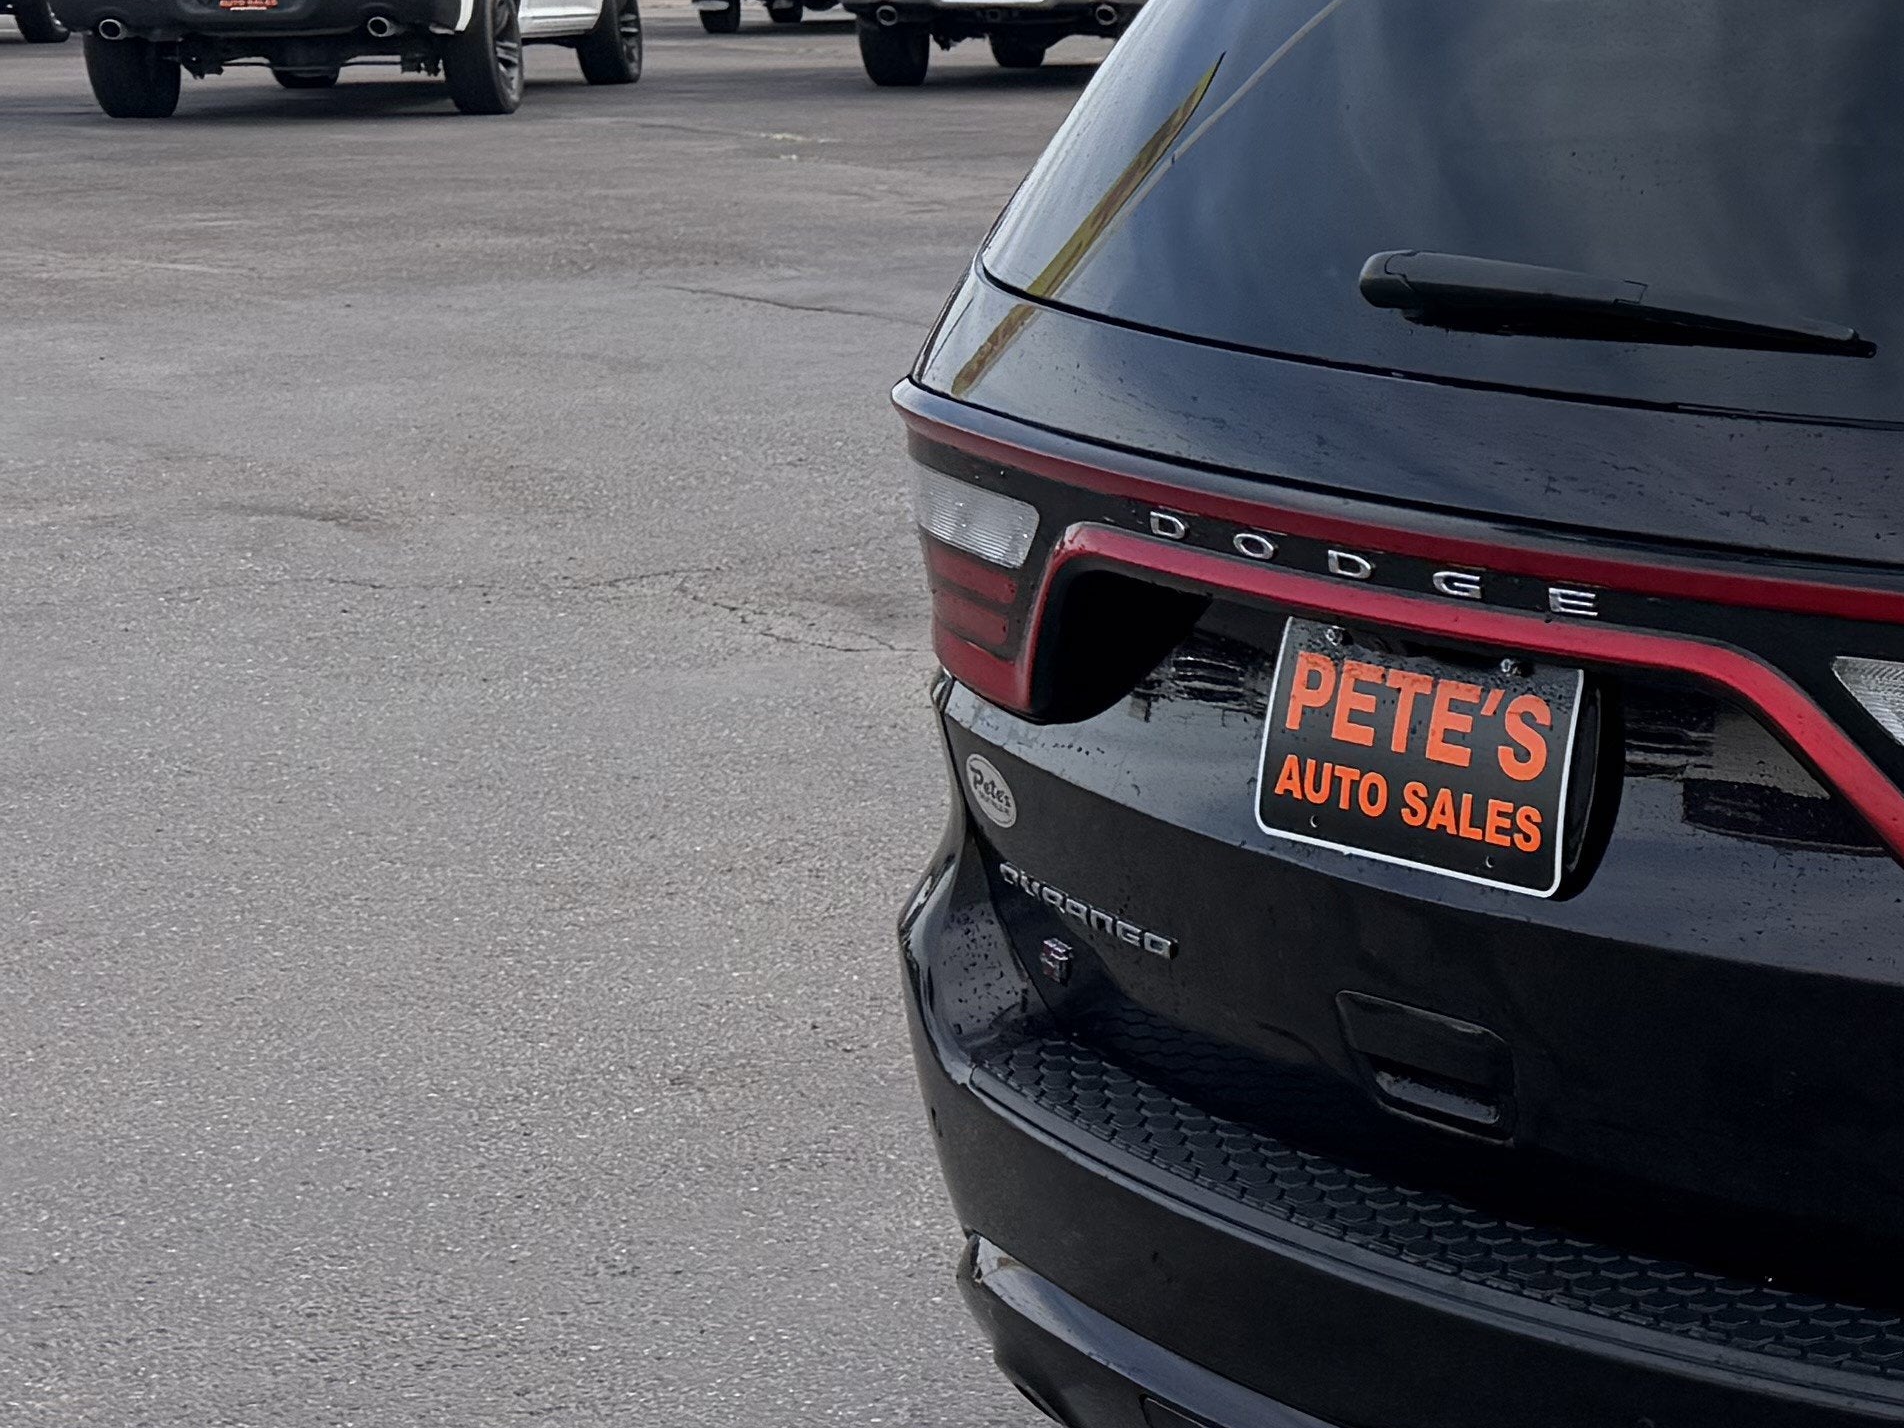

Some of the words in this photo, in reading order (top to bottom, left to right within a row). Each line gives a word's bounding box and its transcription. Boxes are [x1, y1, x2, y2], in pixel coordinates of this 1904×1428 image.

[1149, 509, 1600, 617] DODGE
[1284, 650, 1553, 781] PETE'S
[1273, 753, 1389, 818] AUTO
[1400, 780, 1544, 853] SALES
[1000, 861, 1180, 961] DURANGO
